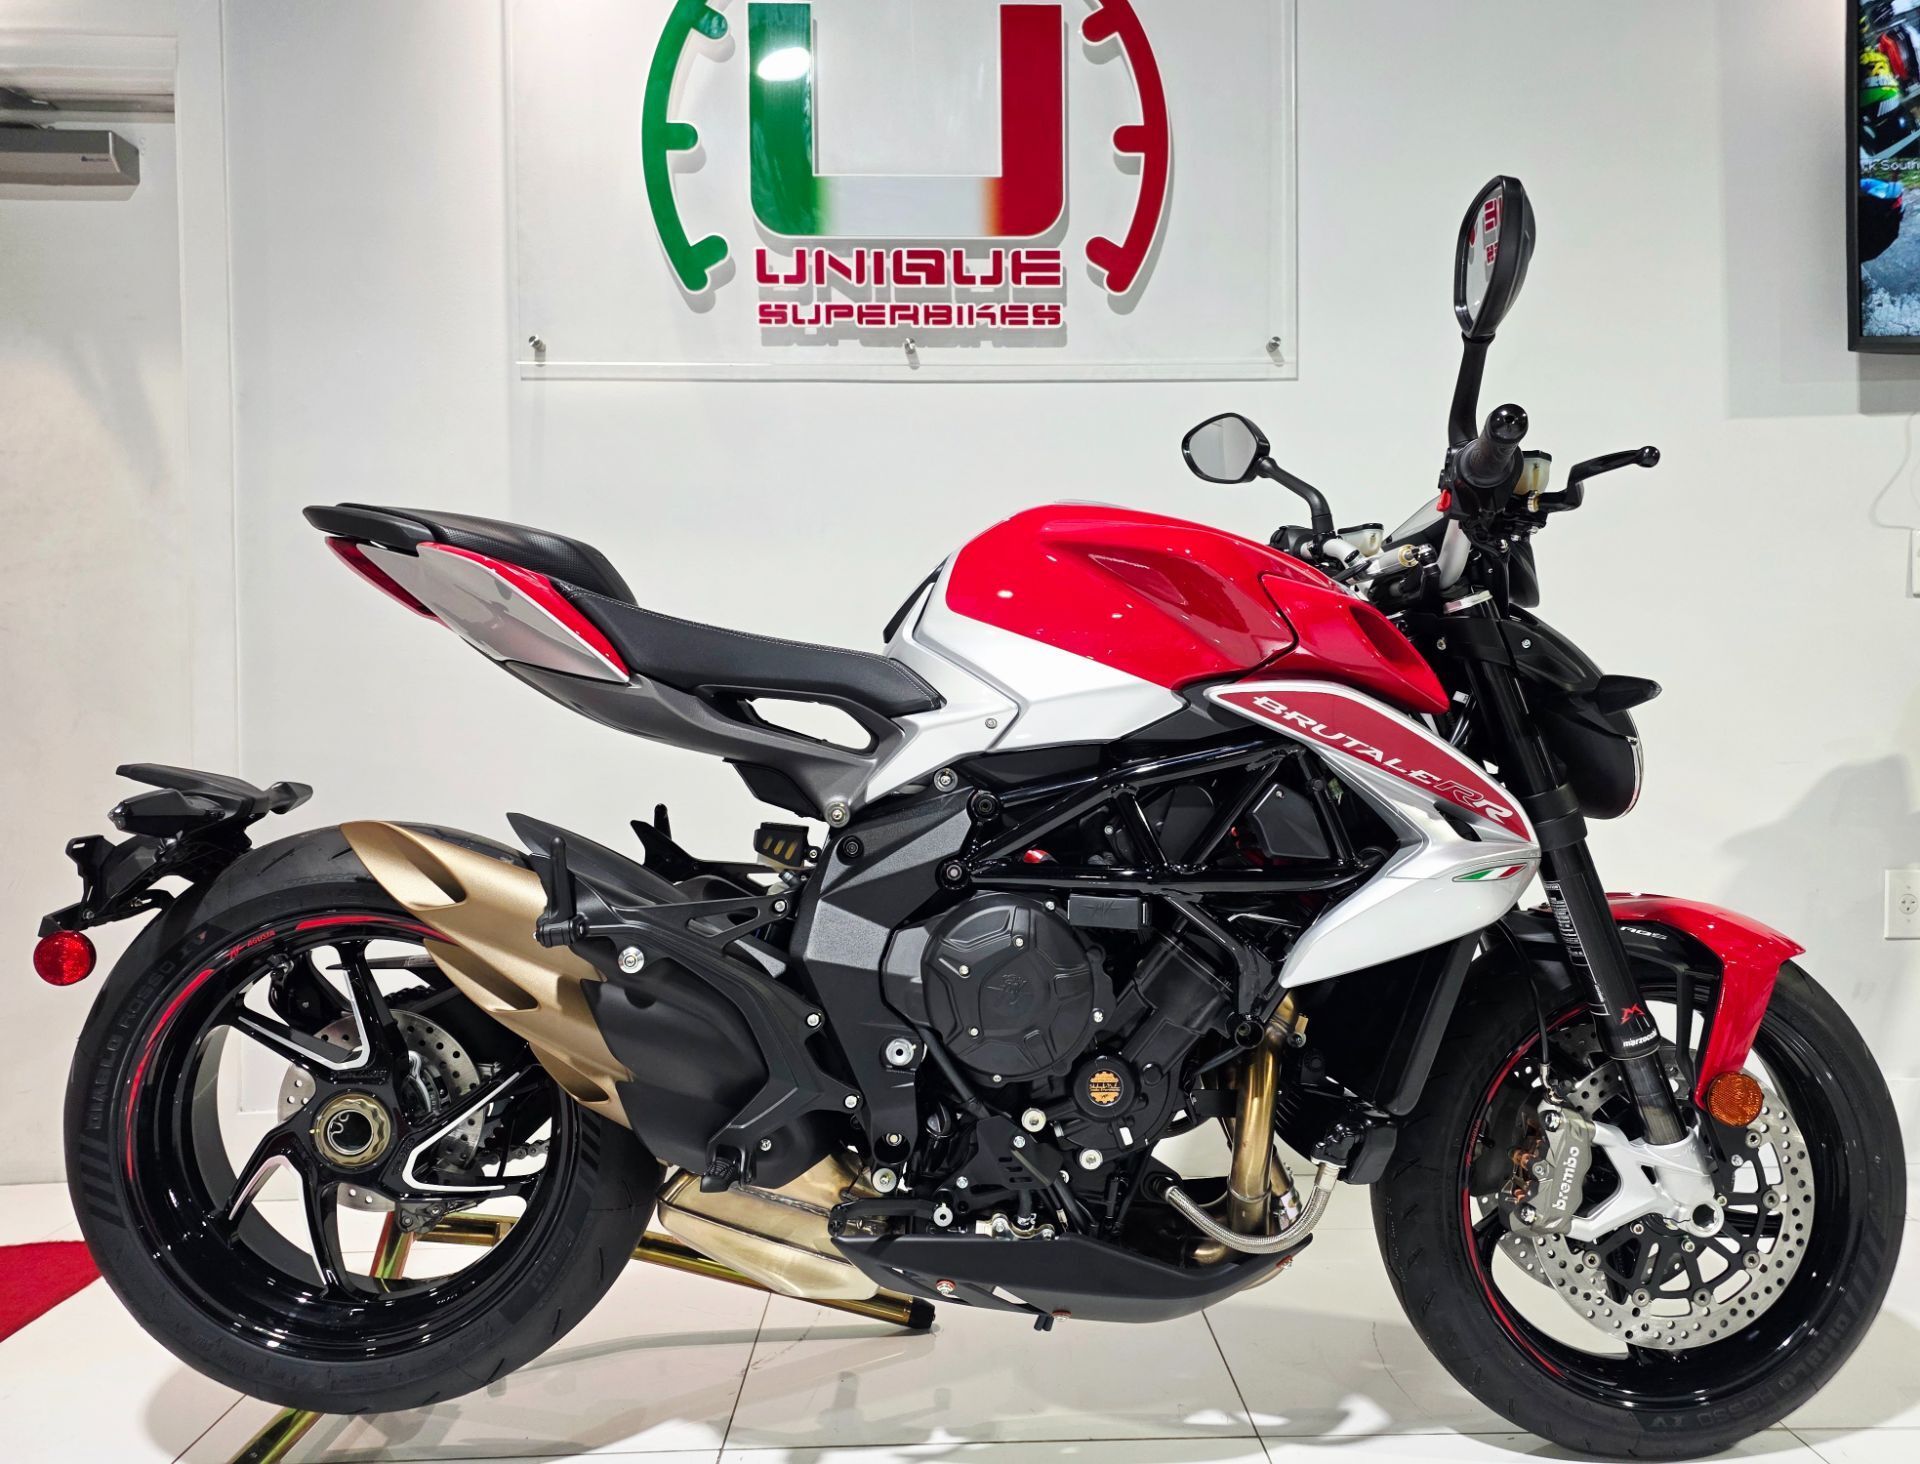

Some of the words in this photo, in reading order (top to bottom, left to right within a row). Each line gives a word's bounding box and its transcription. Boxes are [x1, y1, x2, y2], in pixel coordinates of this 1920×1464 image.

[747, 2, 1064, 238] U
[755, 247, 1063, 287] UNIQUE
[757, 303, 1063, 327] SUPERBIKES
[1253, 696, 1441, 785] BRUTALE
[1434, 780, 1514, 825] RR
[120, 960, 176, 1029] ROSSO
[1552, 1146, 1580, 1211] brembo
